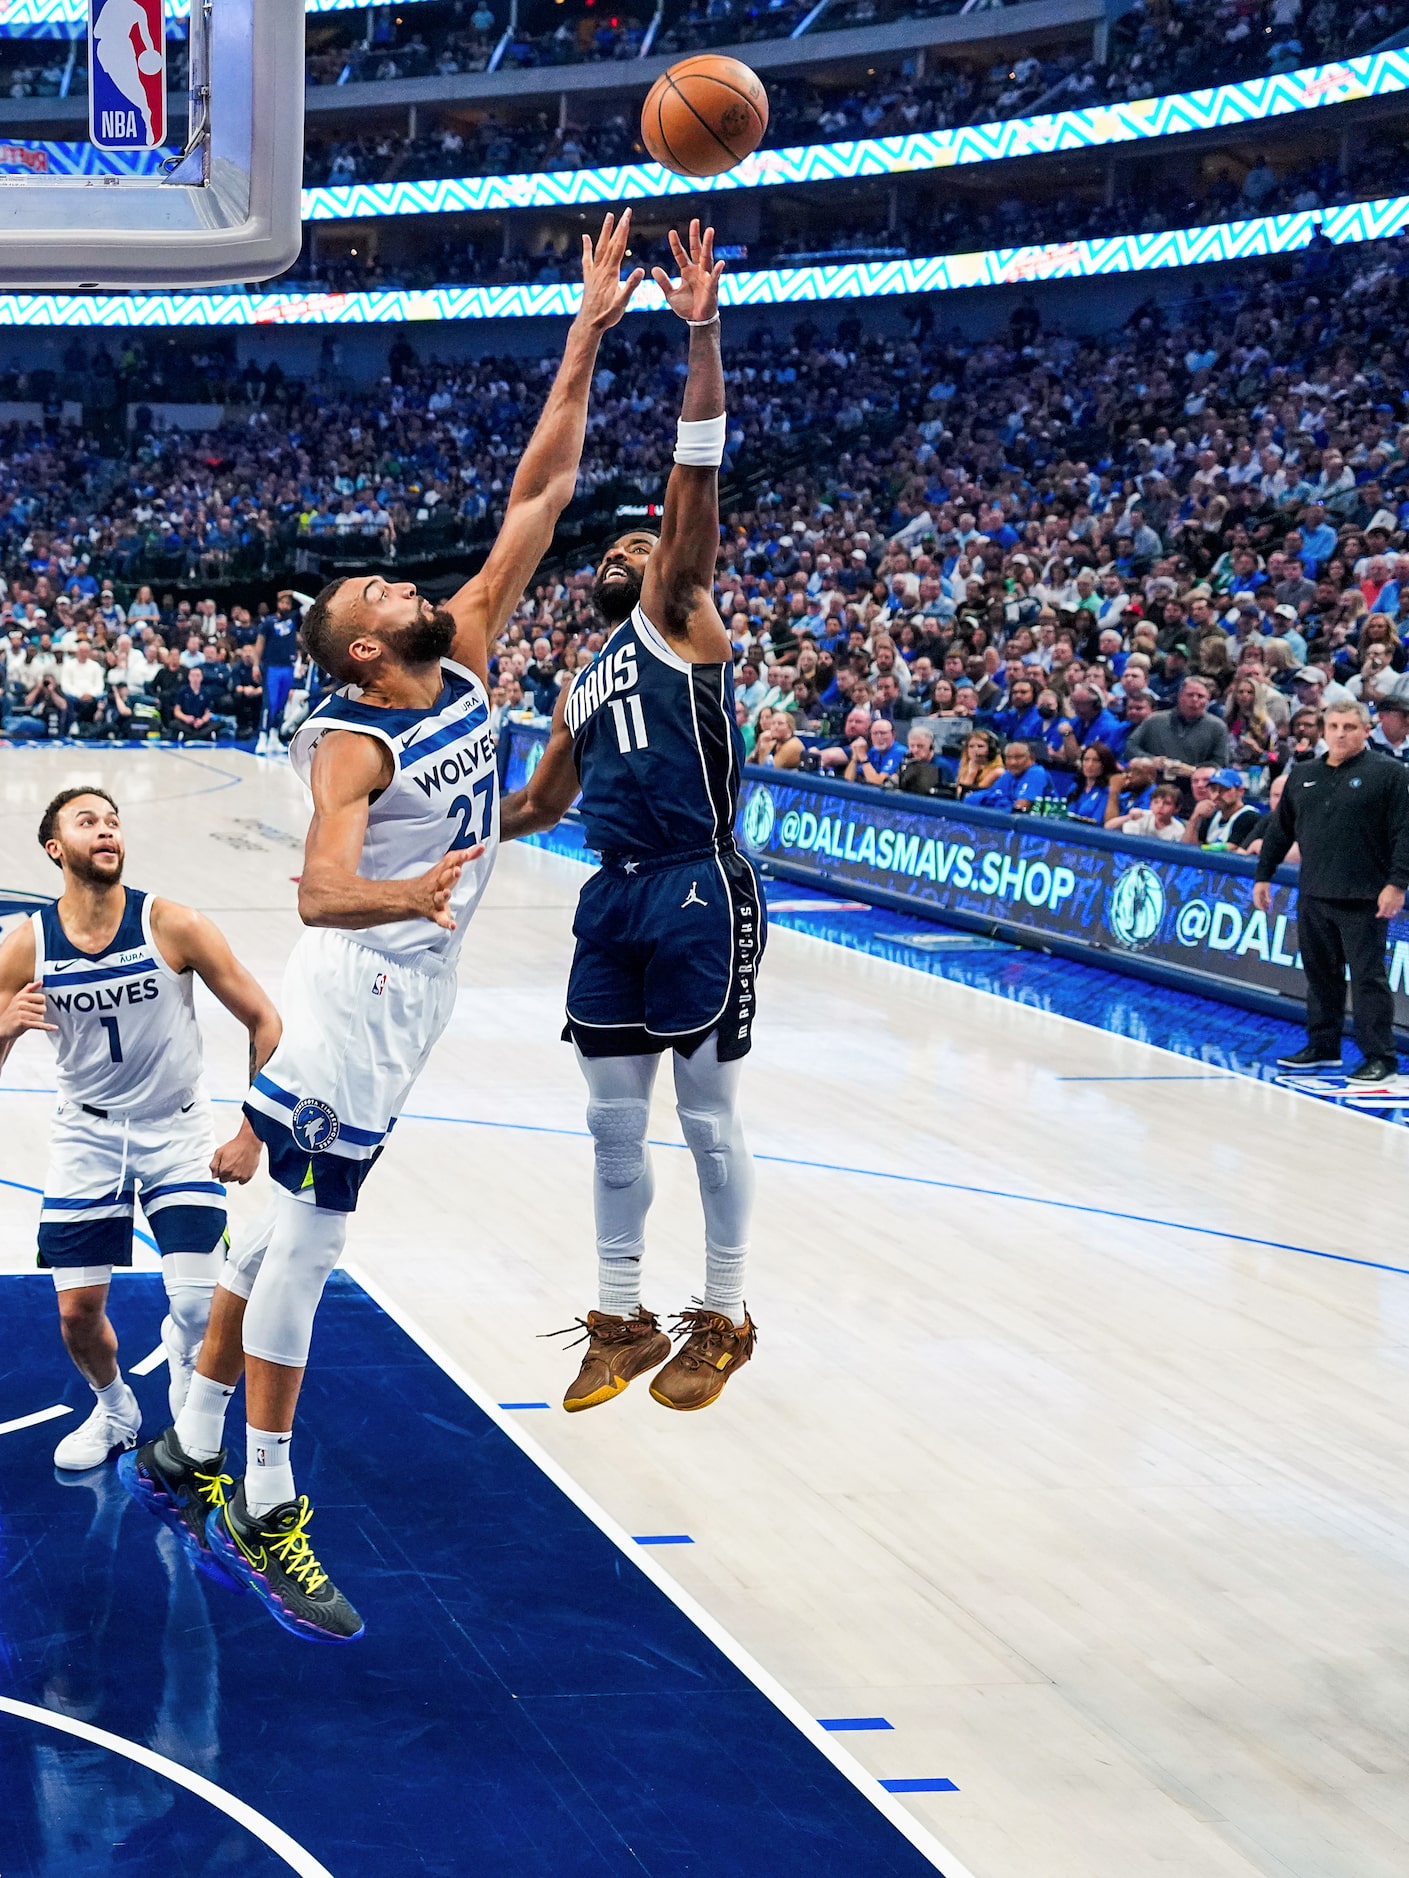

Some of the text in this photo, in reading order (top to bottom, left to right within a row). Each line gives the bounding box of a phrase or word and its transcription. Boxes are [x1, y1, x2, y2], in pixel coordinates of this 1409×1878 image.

[100, 110, 138, 139] NBA
[566, 642, 639, 732] MAVS
[607, 694, 649, 754] 11
[412, 728, 496, 799] WOLVES
[447, 770, 495, 854] 27
[780, 810, 1076, 911] @DALLASMAVS.SHOP
[49, 978, 159, 1014] WOLVES
[100, 1016, 124, 1063] 1
